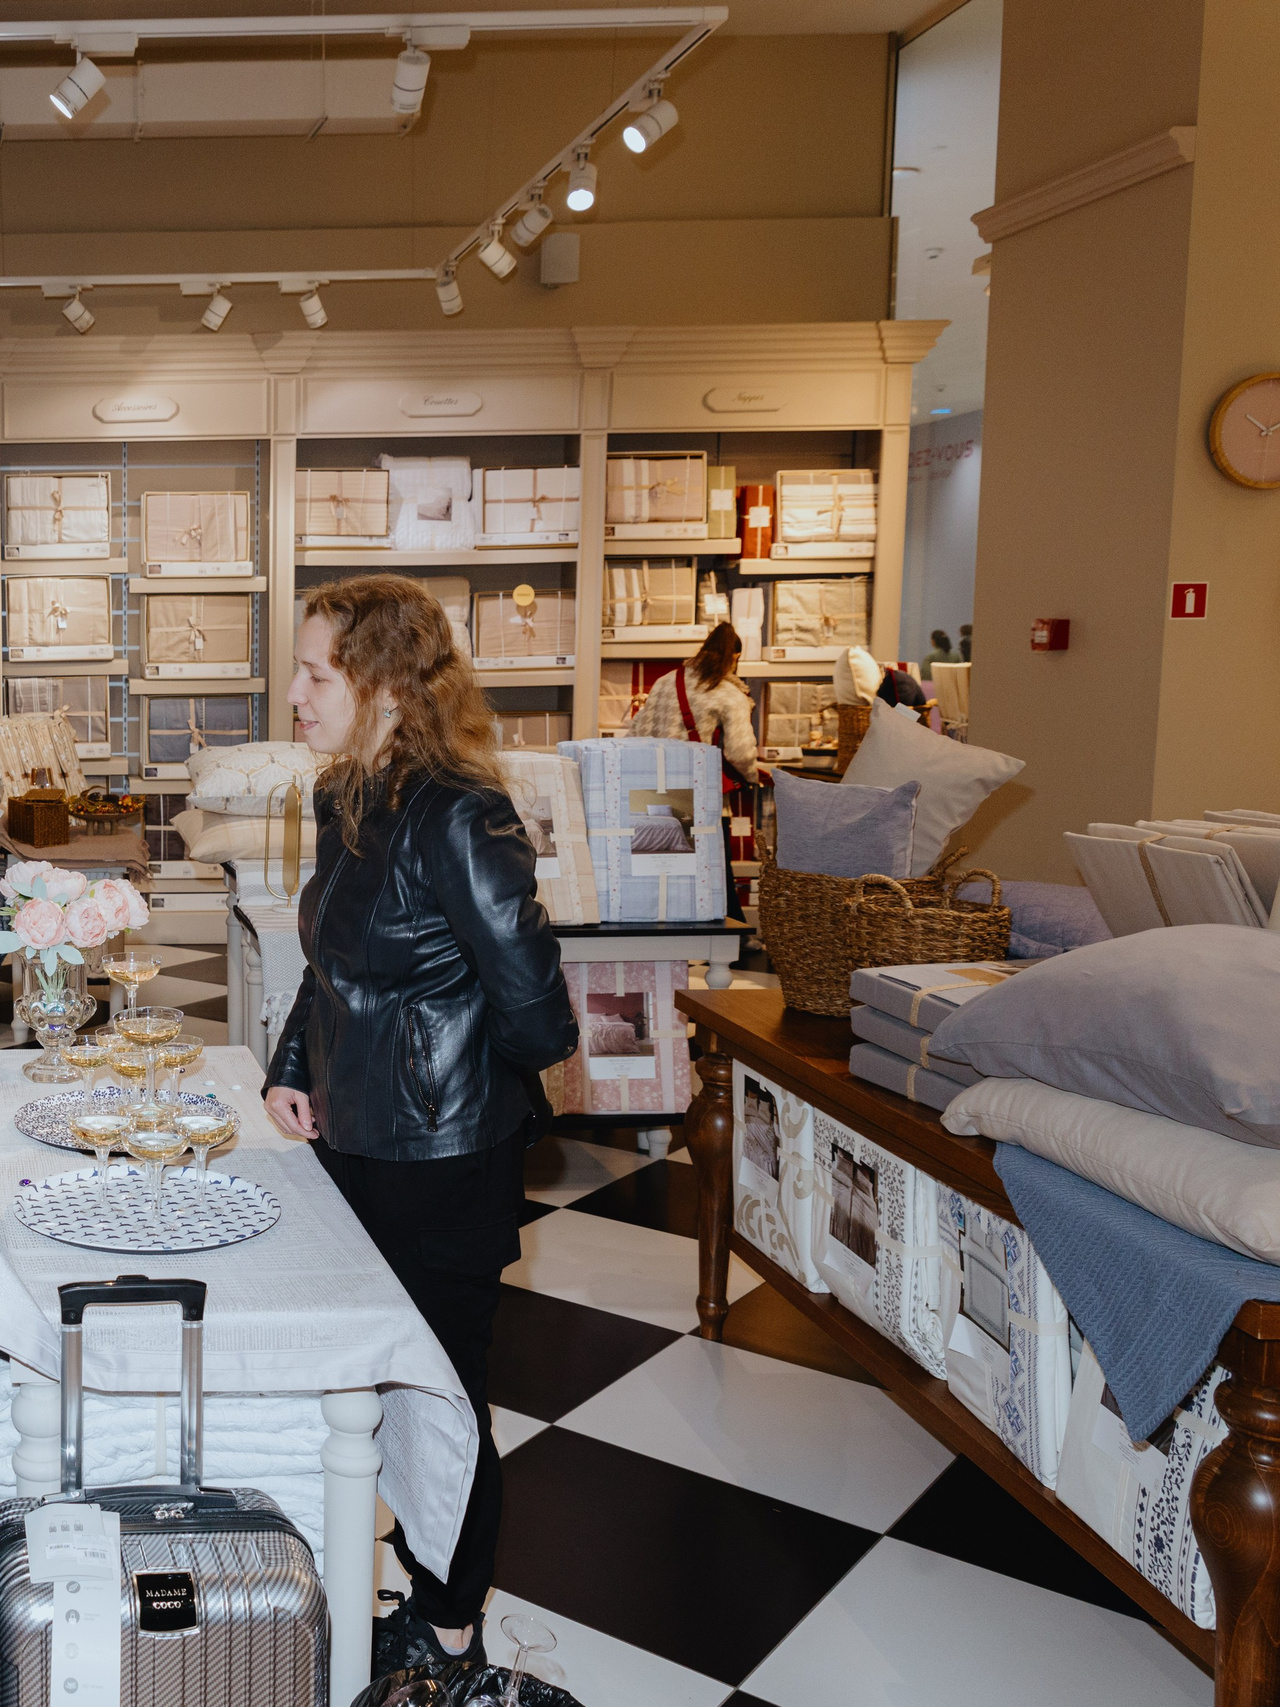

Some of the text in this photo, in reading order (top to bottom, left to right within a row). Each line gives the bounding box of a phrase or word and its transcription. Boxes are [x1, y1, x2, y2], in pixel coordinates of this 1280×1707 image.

[423, 395, 459, 406] Couettes
[111, 402, 158, 412] Accessoires
[145, 1588, 187, 1597] MADAME
[152, 1601, 182, 1609] COCO
